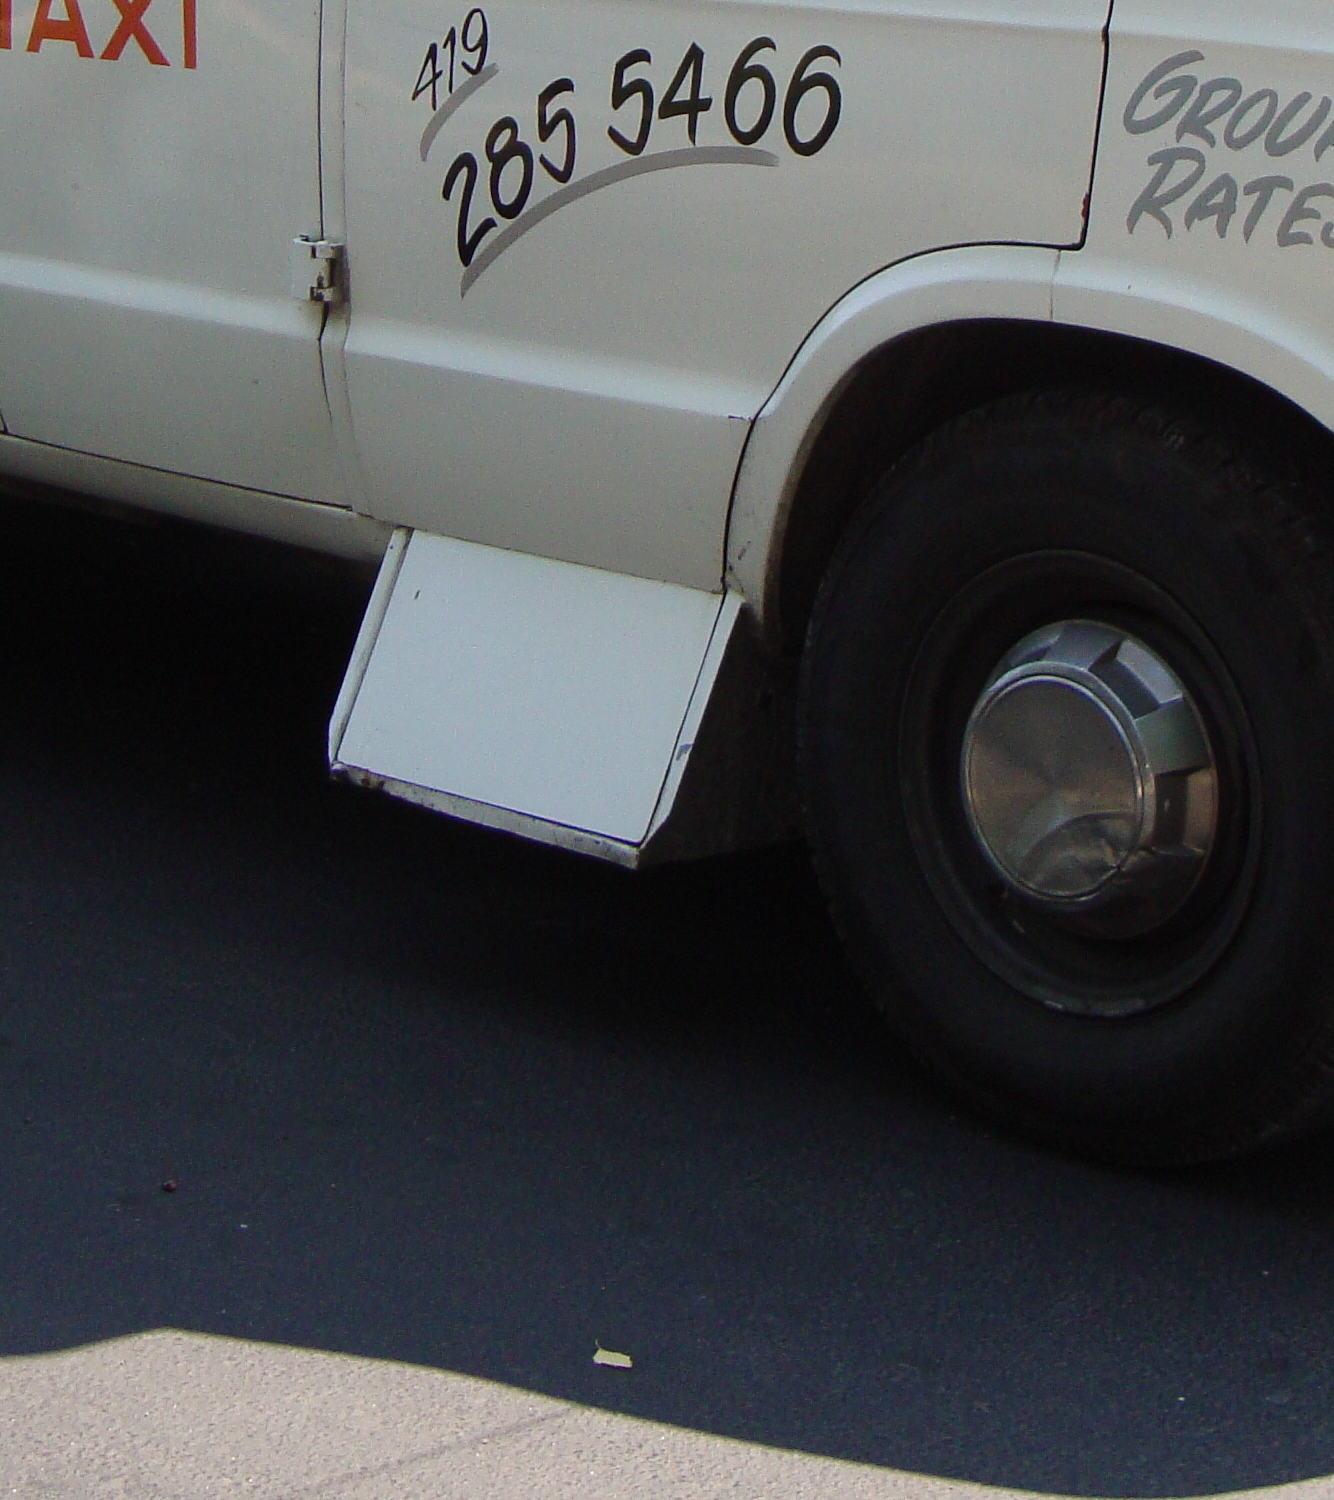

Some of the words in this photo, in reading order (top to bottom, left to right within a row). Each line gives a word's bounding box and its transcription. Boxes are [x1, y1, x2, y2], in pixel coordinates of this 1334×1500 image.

[412, 8, 489, 112] 419
[442, 77, 576, 268] 285
[607, 36, 842, 157] 5466
